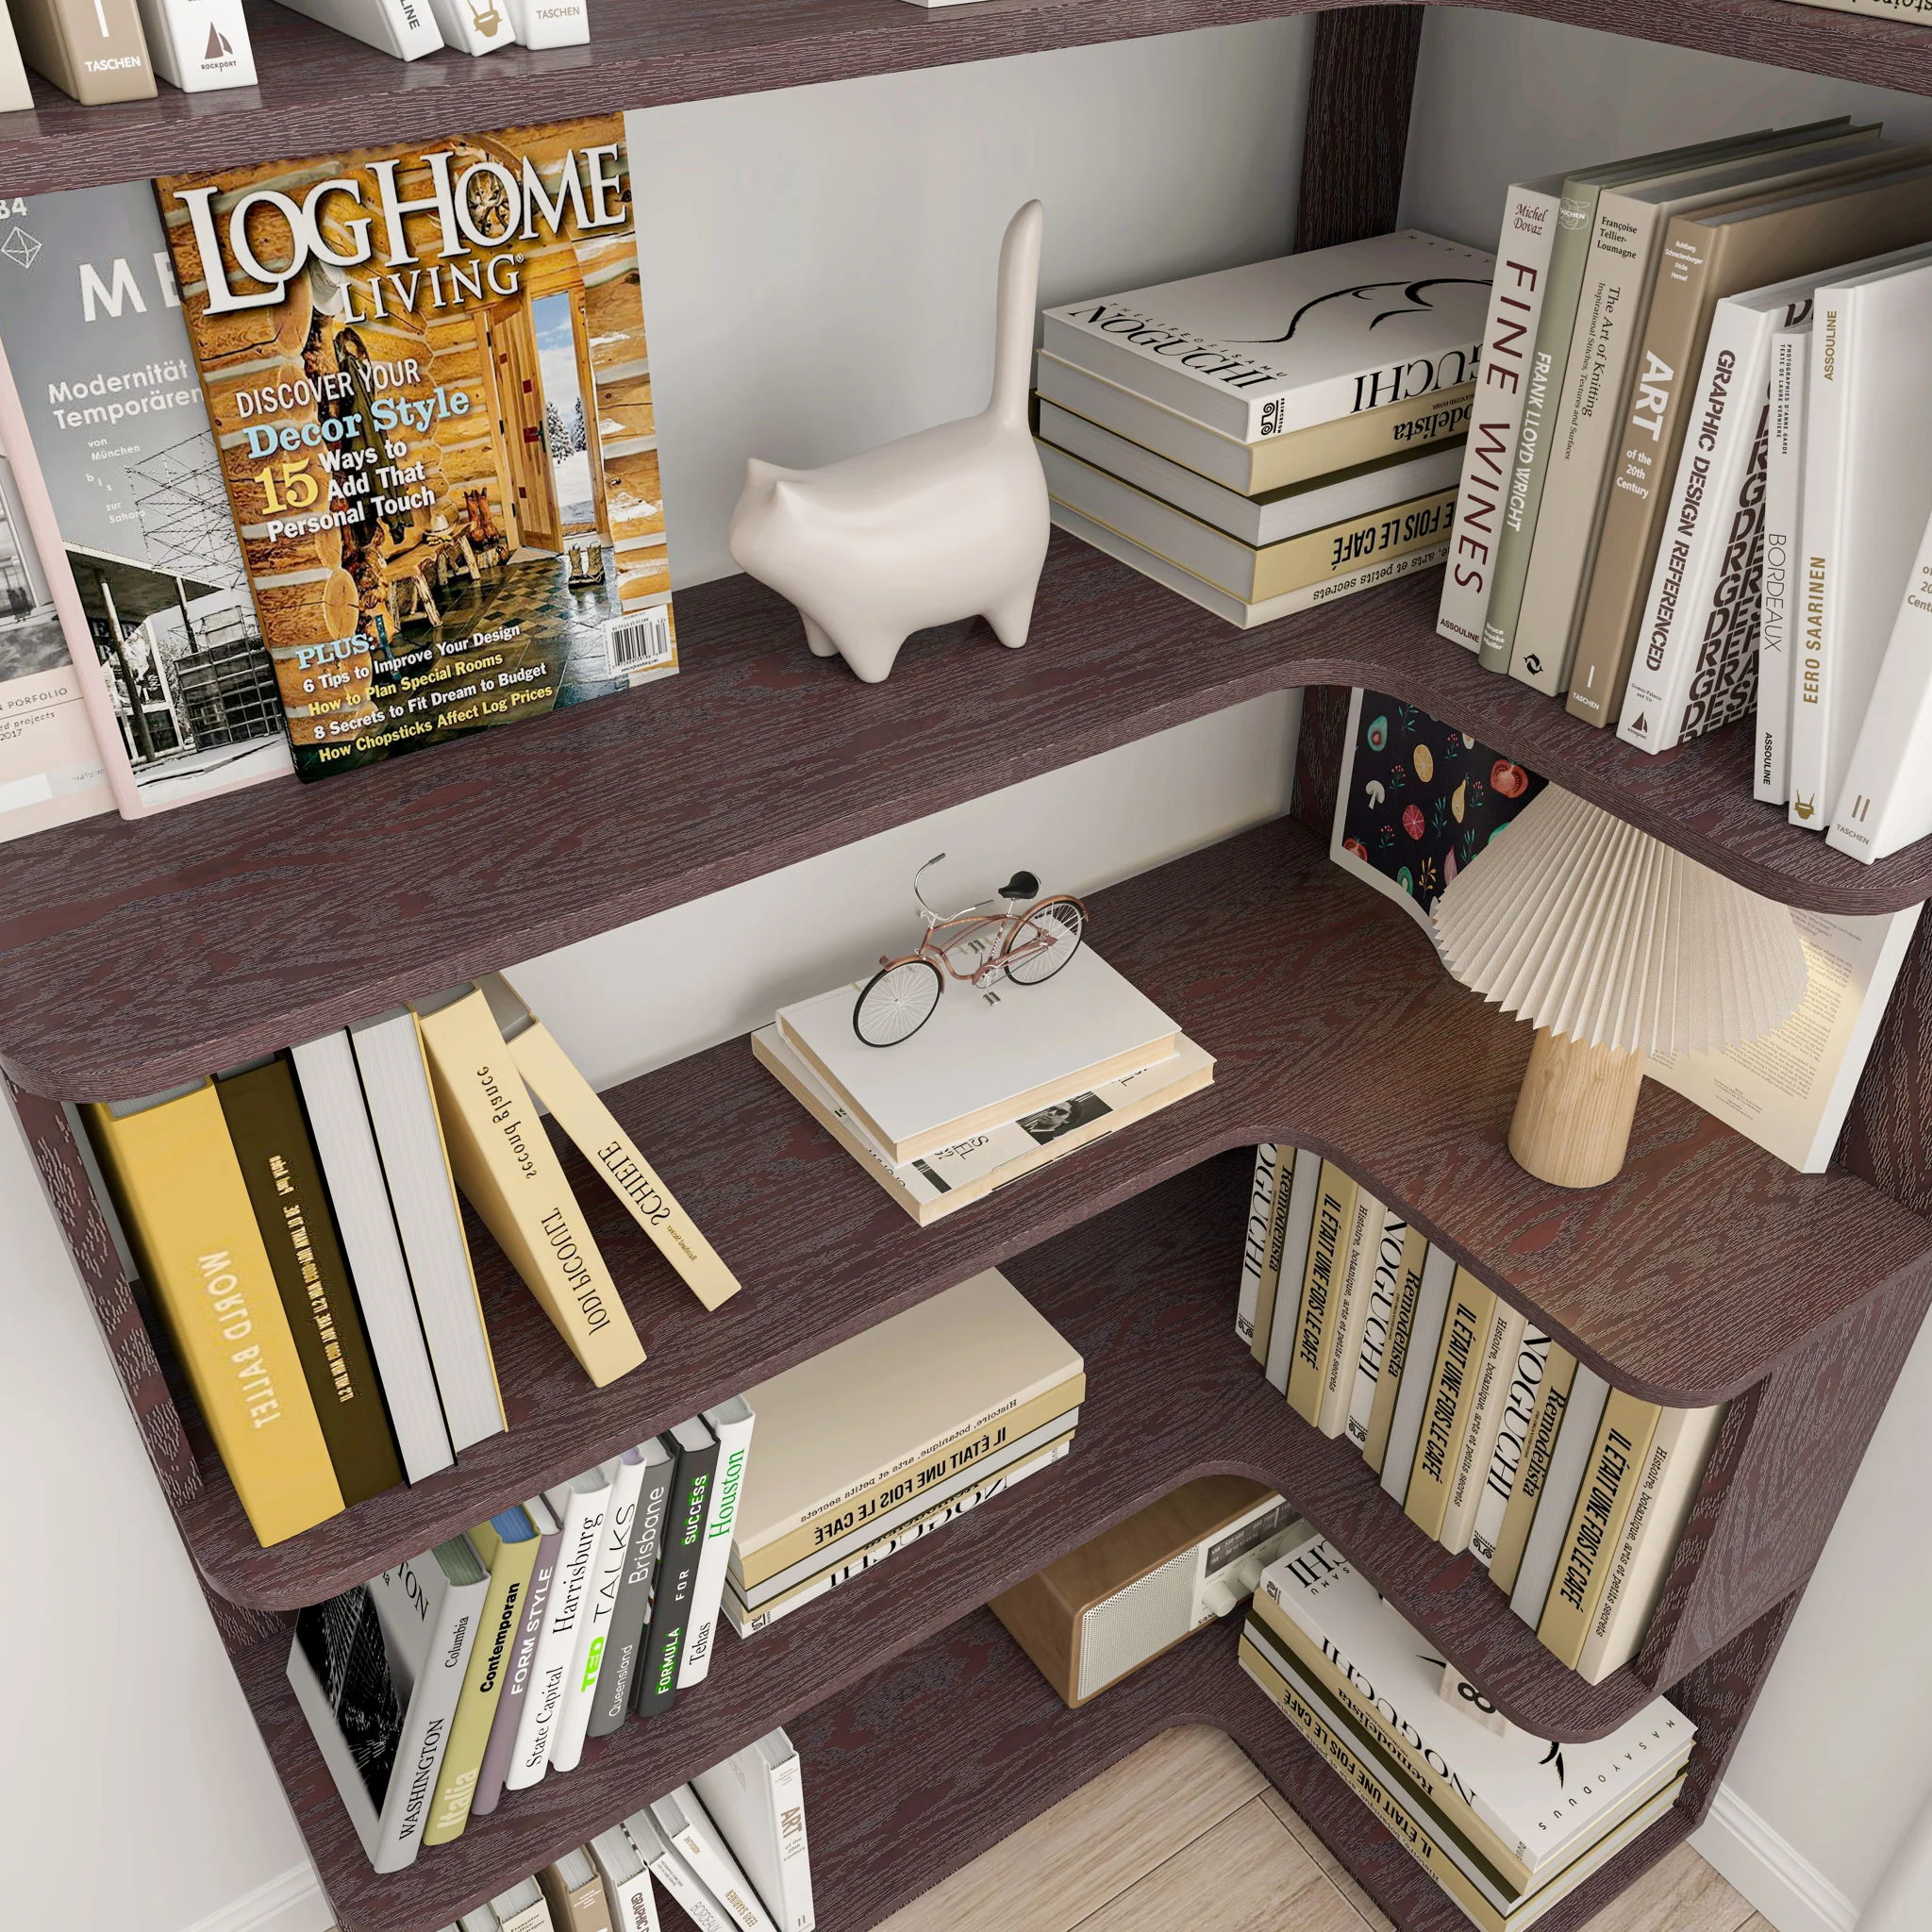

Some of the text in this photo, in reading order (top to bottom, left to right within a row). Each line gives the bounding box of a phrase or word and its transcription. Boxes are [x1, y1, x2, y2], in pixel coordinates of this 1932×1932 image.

[536, 7, 580, 21] TASCHEN
[85, 57, 141, 72] TASCHEN
[201, 60, 238, 72] ROCKPORT
[1513, 217, 1542, 236] Dovaz
[1515, 203, 1549, 223] Michel
[1601, 216, 1638, 234] Françoise
[1597, 240, 1637, 259] Loumagne
[1486, 259, 1538, 394] FINE
[1589, 282, 1606, 339] Inspirational
[1068, 305, 1279, 391] NOGUCHI
[1581, 287, 1621, 418] The Art of Knitting
[1581, 338, 1594, 371] Stitches,
[1824, 310, 1838, 381] ASSOULINE
[48, 358, 189, 405] Modernität
[236, 359, 421, 419] DISCOVER YOUR
[1575, 374, 1588, 408] Textures
[1632, 351, 1674, 441] ART
[1697, 349, 1736, 452] GRAPHIC
[88, 438, 108, 448] von
[242, 387, 470, 459] Decor Style
[1507, 351, 1552, 532] FRANK LLOYD WRIGHT
[1565, 424, 1577, 460] Surfaces
[92, 444, 141, 460] München
[320, 441, 407, 474] Ways to
[1625, 464, 1645, 479] 20th
[1626, 449, 1652, 466] of the
[254, 458, 320, 516] 15
[326, 463, 425, 503] Add That
[1454, 423, 1511, 594] WINES
[1616, 477, 1649, 499] Century
[1677, 457, 1710, 537] DESIGN
[267, 489, 436, 542] Personal Touch
[1331, 505, 1441, 571] FOIS LE CAFÉ
[1313, 551, 1435, 600] arts et petits secrets
[1763, 532, 1787, 654] BORDEAUX
[1440, 618, 1480, 643] ASSOULINE
[1646, 540, 1690, 672] REFERENCED
[1803, 557, 1826, 705] EERO SAARINEN
[295, 633, 376, 670] PLUS:
[302, 624, 521, 694] 6 Tips to Improve Your Design
[308, 652, 504, 717] How to Plan Special Rooms
[313, 660, 547, 741] 8 Secrets to Fit Dream to Budget
[1573, 691, 1599, 709] TASCHEN
[319, 684, 554, 763] How Chopsticks Affect Log Prices
[1762, 731, 1773, 786] ASSOULINE
[1836, 824, 1870, 846] TASCHEN
[1388, 1268, 1420, 1378] Remodelista
[1523, 1385, 1567, 1498] Remodelista
[708, 1448, 744, 1541] Houston
[1560, 1427, 1632, 1613] IL ÉTAIT UNE FOIS LE CAFÉ
[1621, 1542, 1634, 1565] arts
[581, 1503, 635, 1692] TED TALKS
[608, 1486, 664, 1717] Queensland Brisbane
[658, 1474, 707, 1695] FORMULA FOR SUCCESS
[1607, 1574, 1623, 1606] petits
[444, 1616, 469, 1668] Columbia
[480, 1582, 520, 1692] Contemporan
[511, 1566, 553, 1695] FORM STYLE
[526, 1513, 604, 1768] State Capital Harrisburg
[689, 1622, 710, 1666] Tehas
[1595, 1604, 1613, 1639] secrets
[1457, 1682, 1496, 1714] 8
[399, 1718, 444, 1840] WASHINGTON
[437, 1767, 478, 1829] Italia
[781, 1807, 802, 1839] ART
